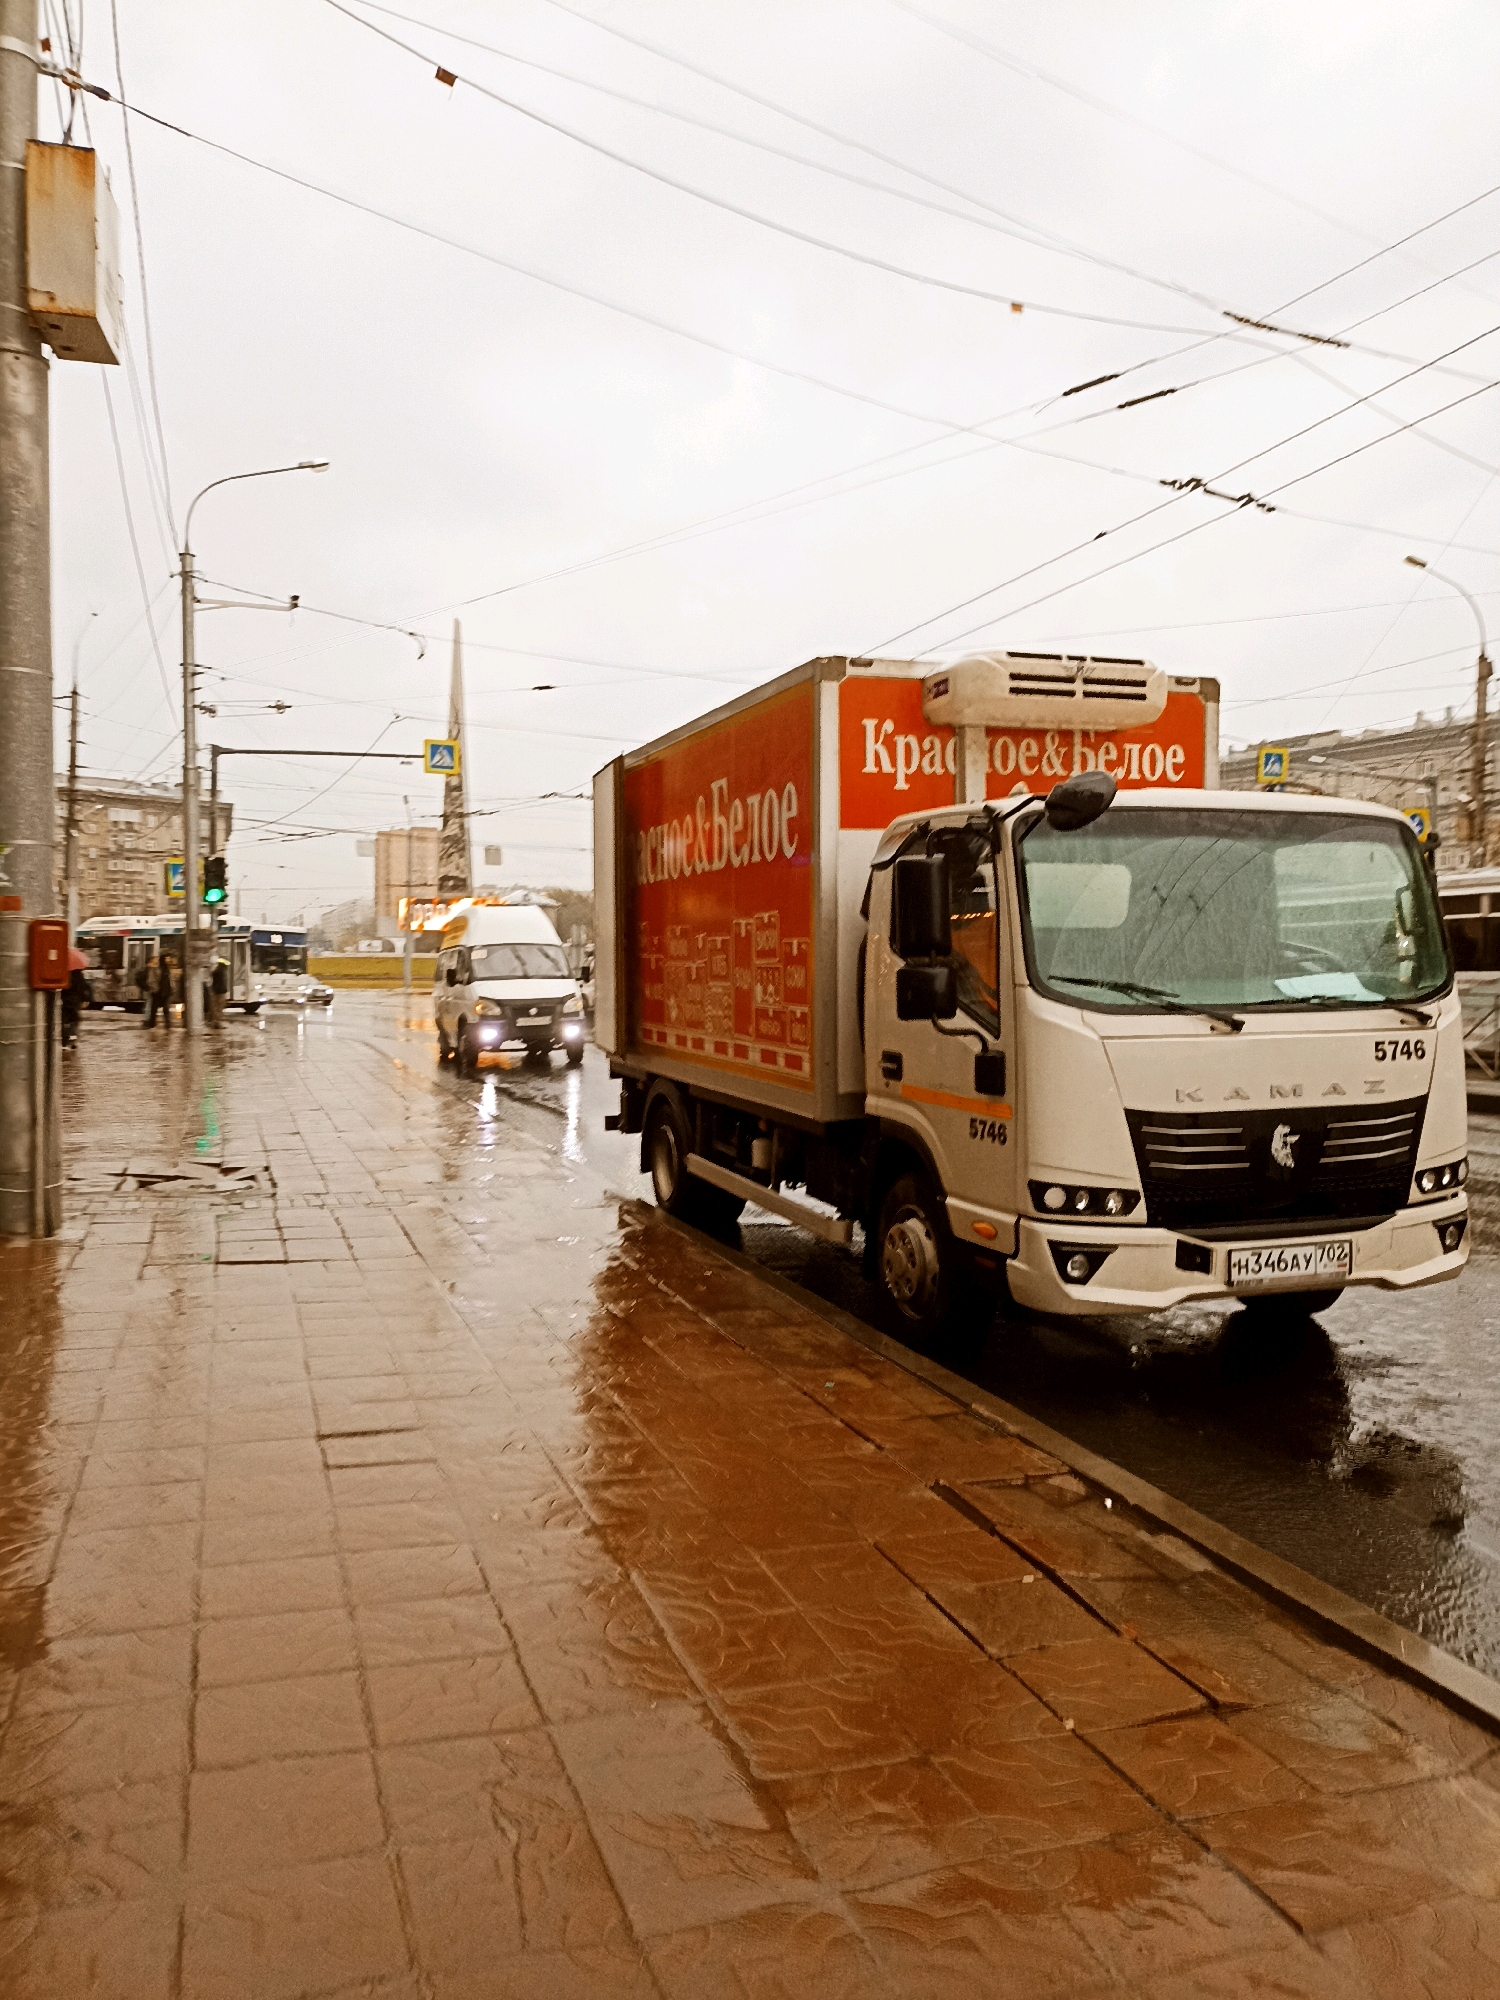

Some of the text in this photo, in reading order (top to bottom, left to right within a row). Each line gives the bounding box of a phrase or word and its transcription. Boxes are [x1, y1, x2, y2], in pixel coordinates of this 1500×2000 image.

[1374, 1039, 1426, 1062] 5746
[1175, 1079, 1386, 1103] KAMAZ
[969, 1116, 1008, 1146] 5746
